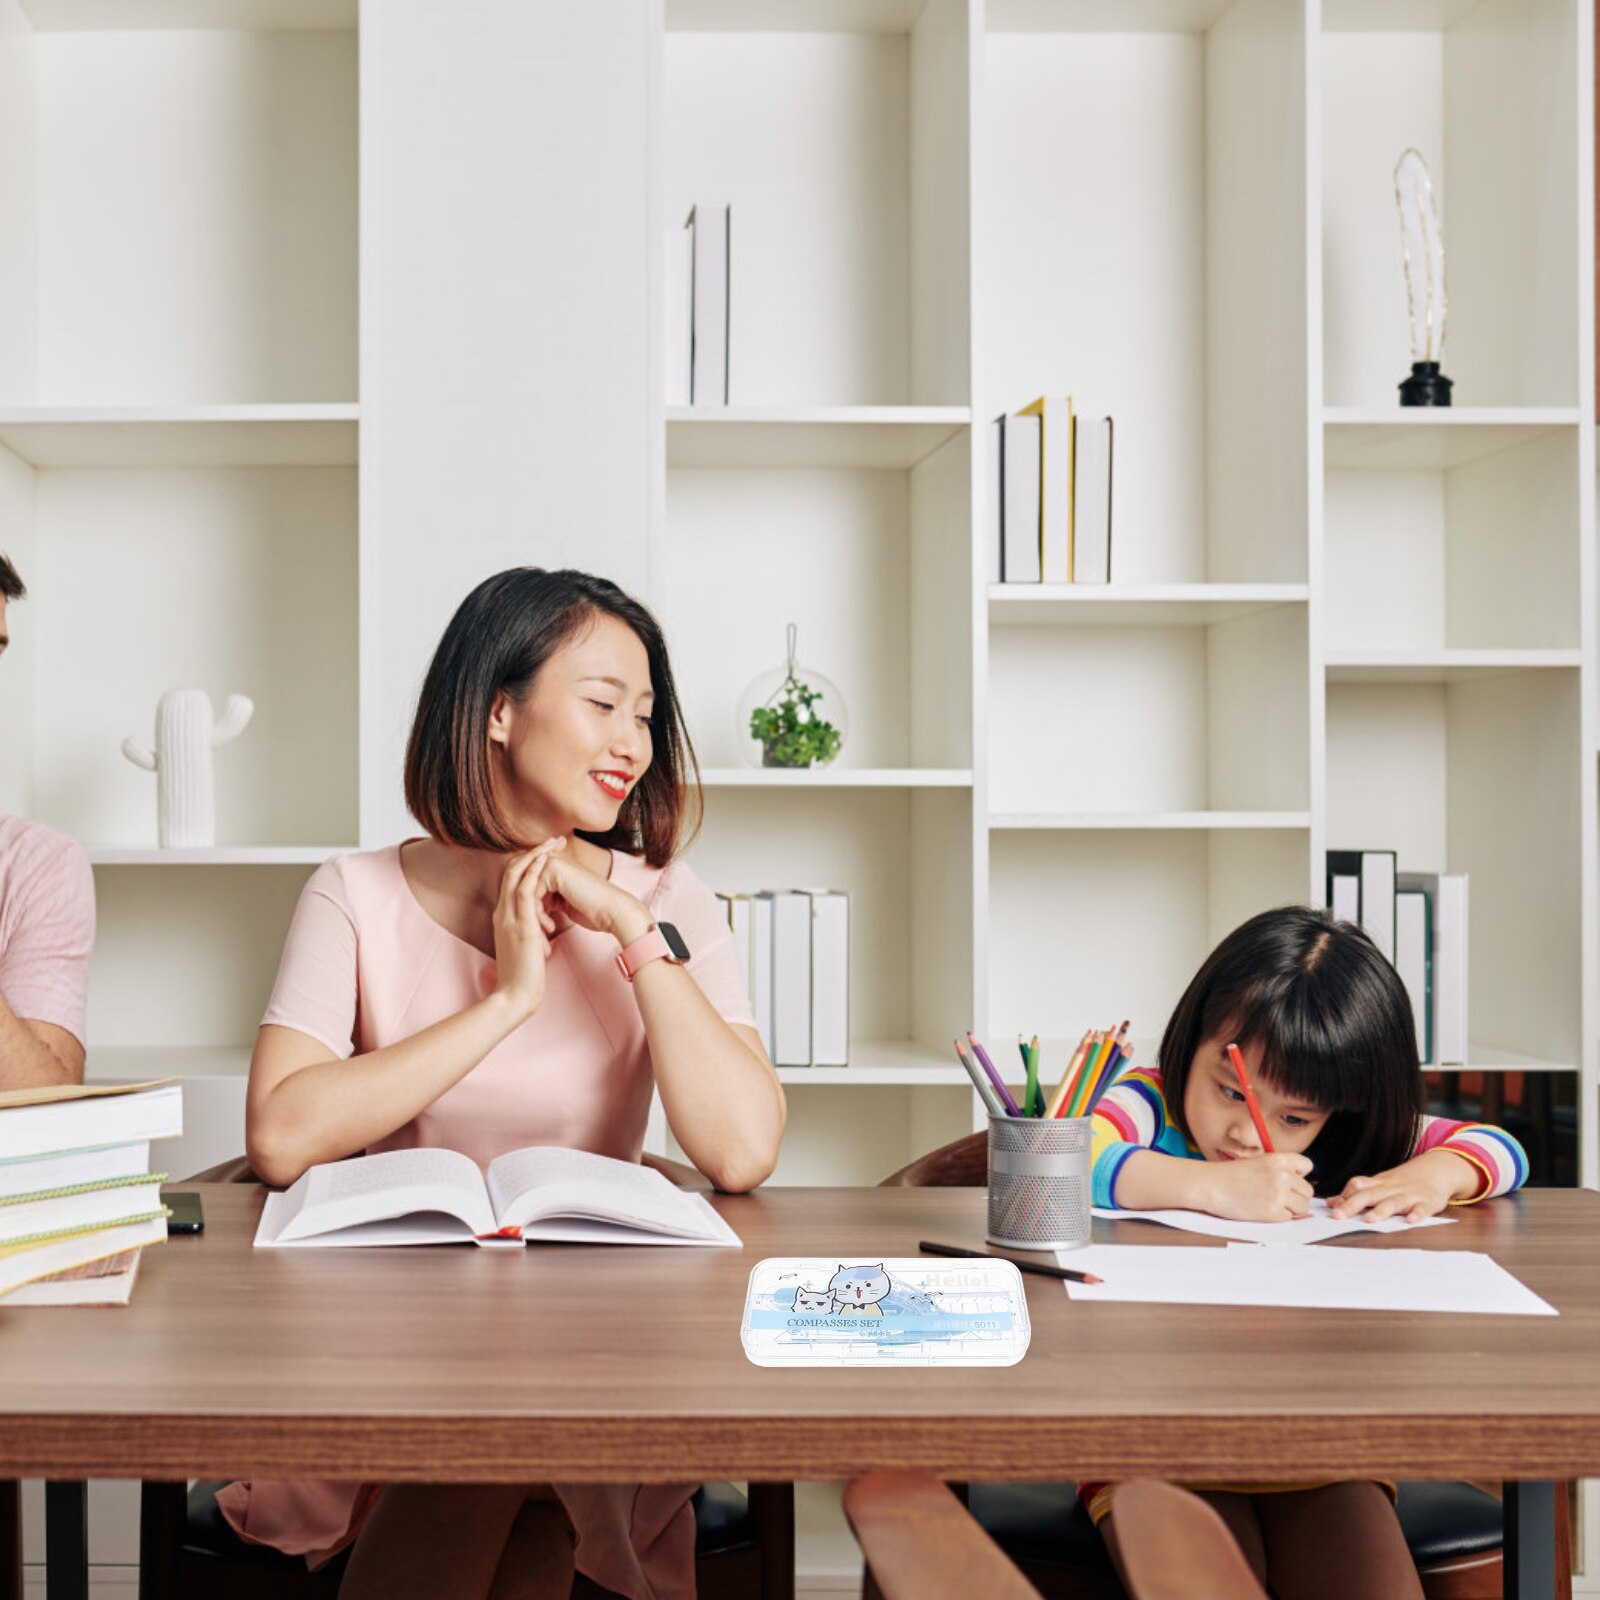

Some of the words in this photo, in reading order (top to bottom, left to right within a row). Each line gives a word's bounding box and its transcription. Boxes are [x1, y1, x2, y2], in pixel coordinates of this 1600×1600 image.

[926, 1272, 989, 1288] Hello!
[787, 1319, 857, 1328] COMPASSES
[859, 1319, 883, 1328] SET
[974, 1321, 996, 1329] 5011
